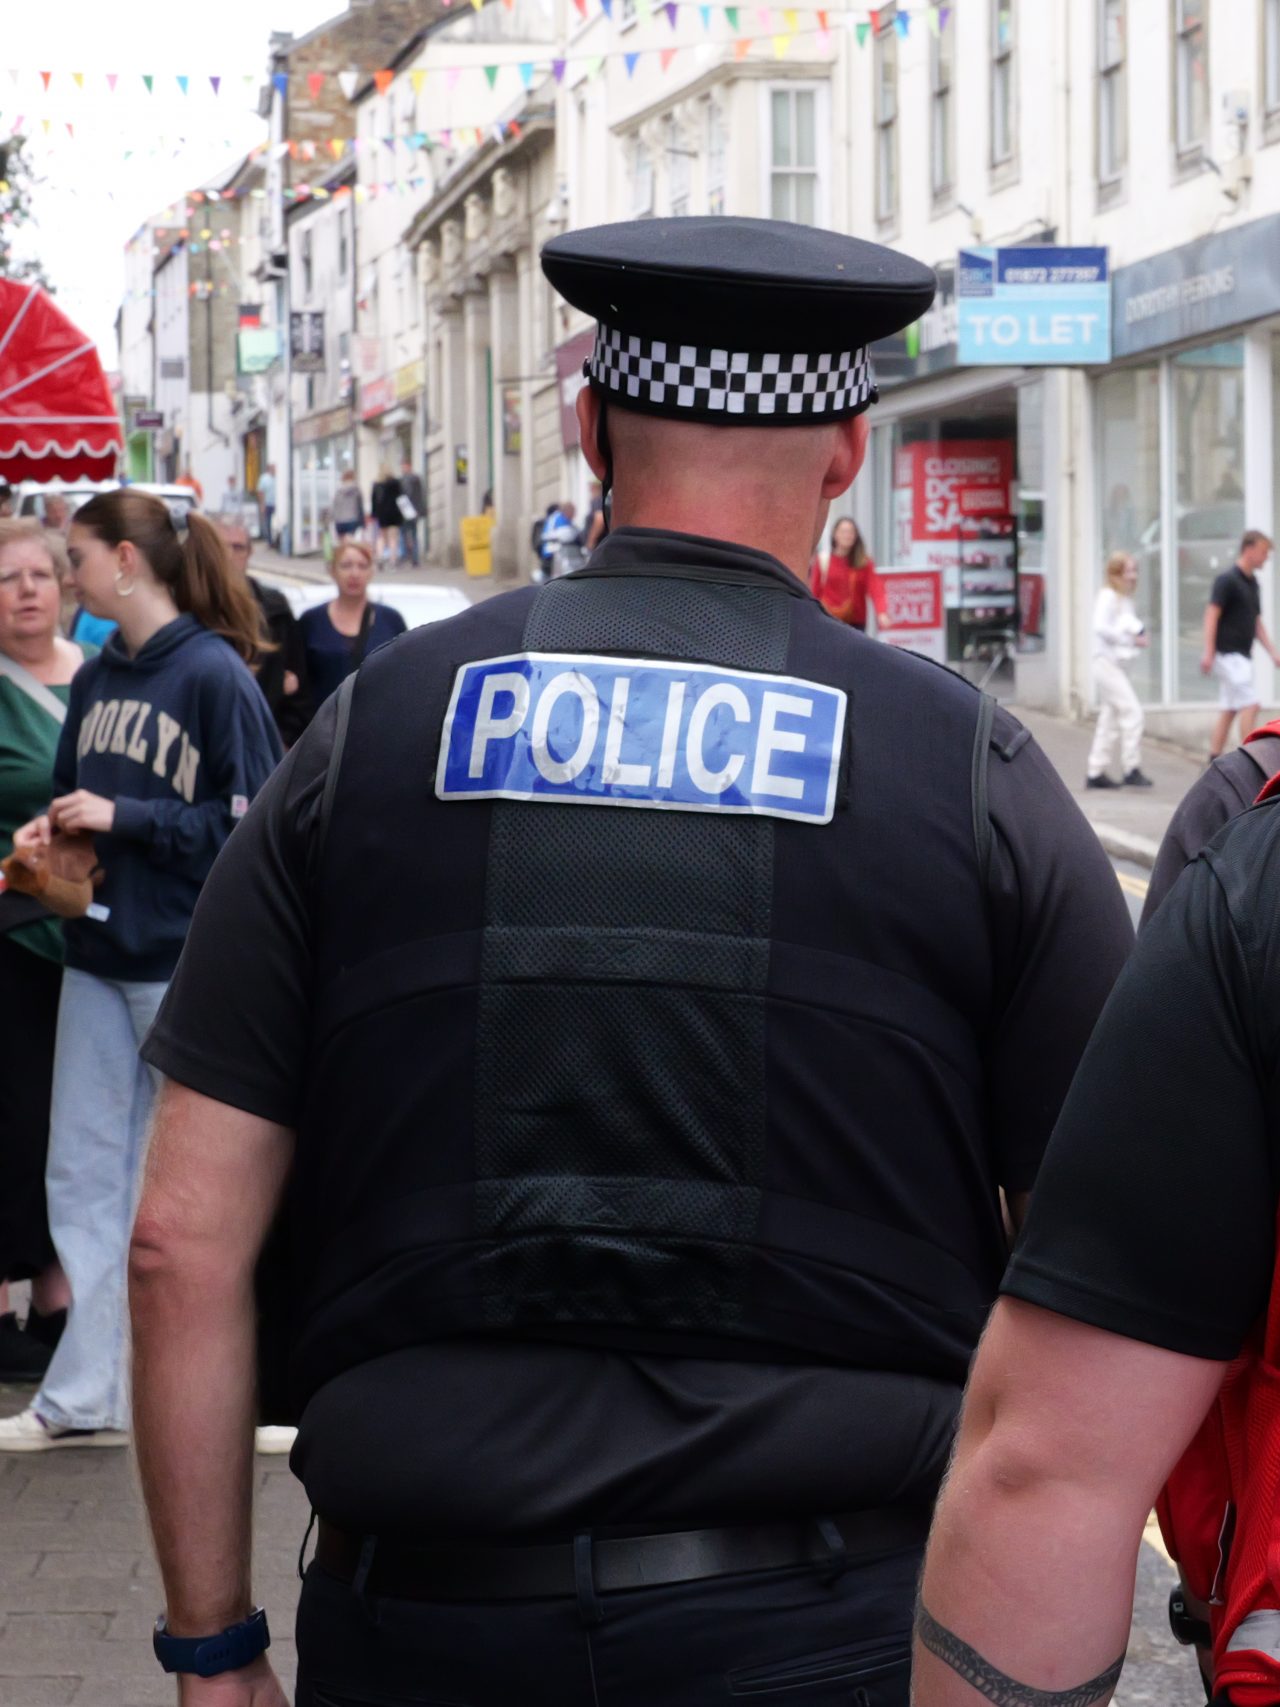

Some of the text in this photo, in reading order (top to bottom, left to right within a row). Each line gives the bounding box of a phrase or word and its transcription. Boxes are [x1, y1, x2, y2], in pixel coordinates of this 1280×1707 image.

[967, 314, 1020, 347] TO
[1028, 314, 1099, 346] LET
[925, 457, 999, 476] CLOSING
[887, 603, 935, 624] SALE
[468, 671, 814, 800] POLICE
